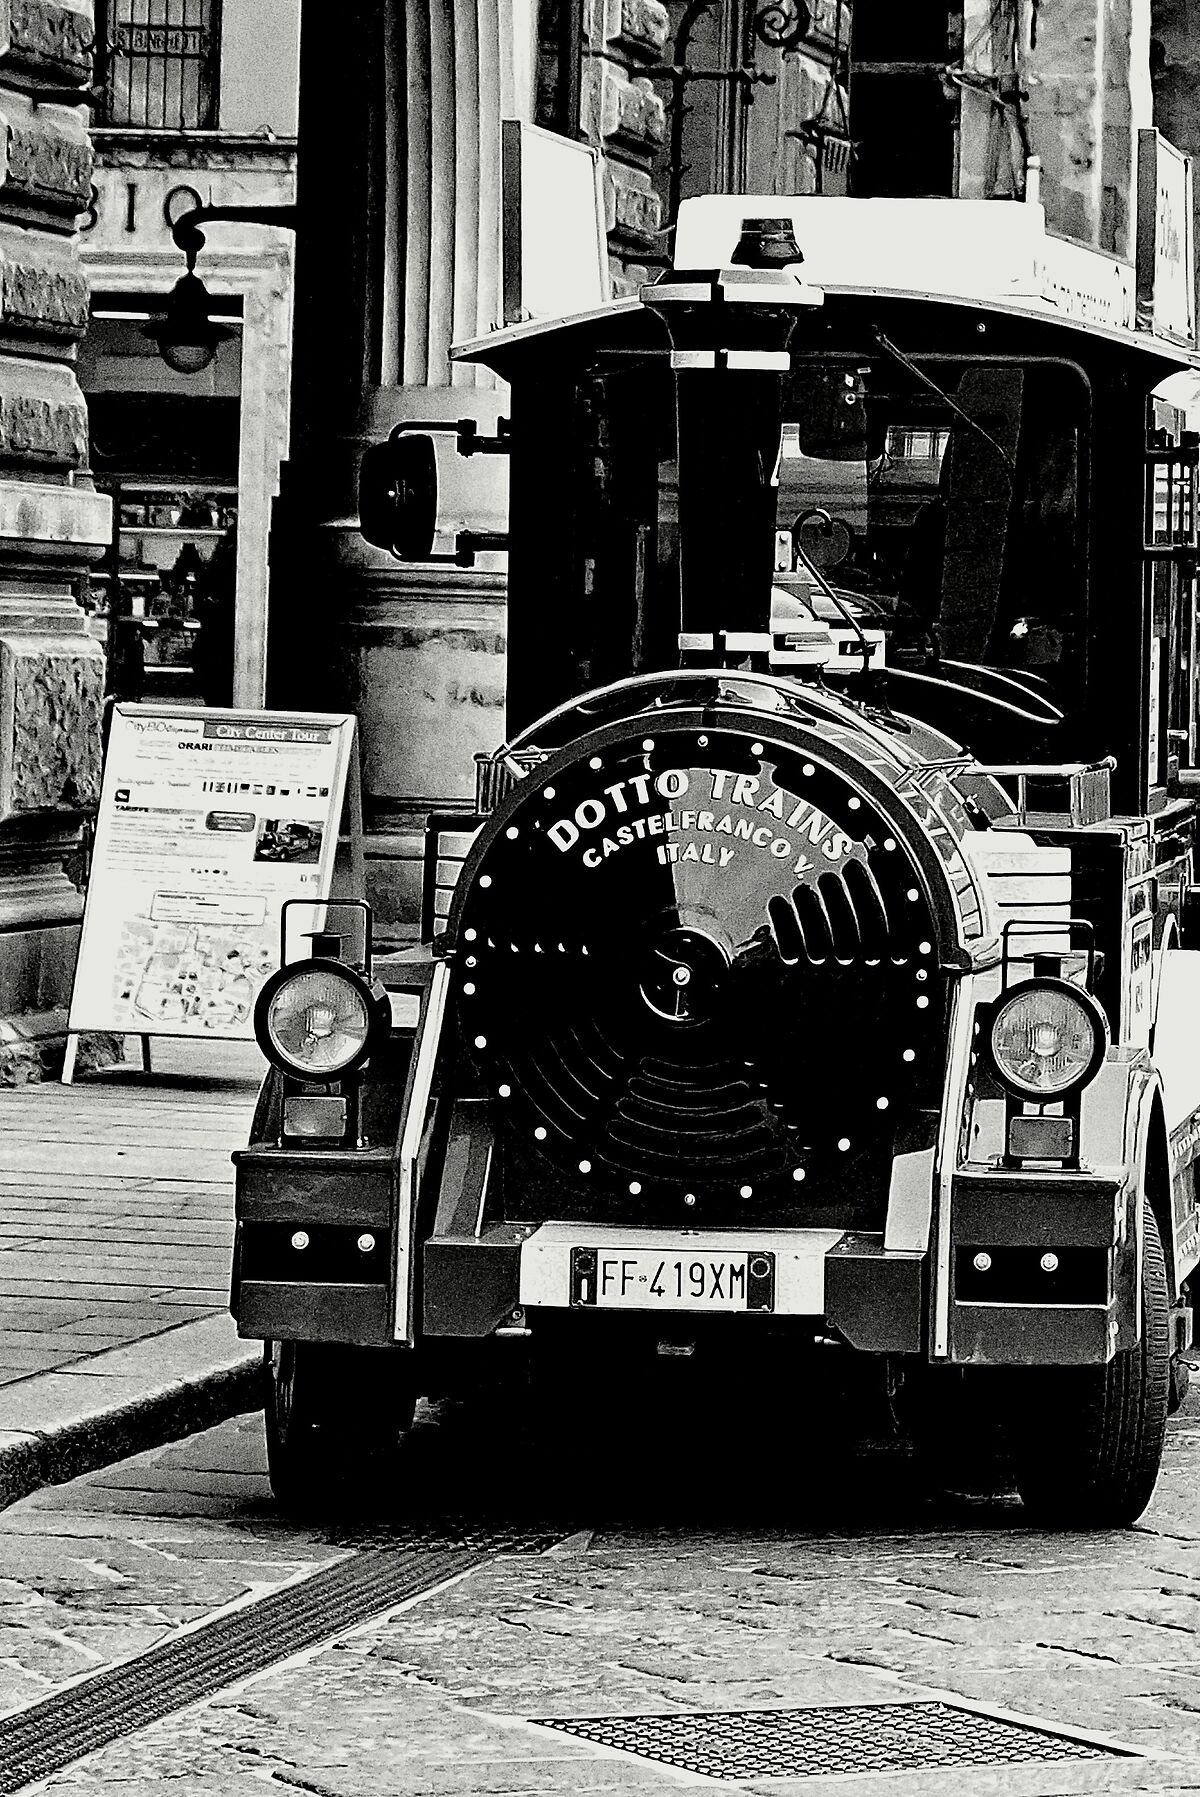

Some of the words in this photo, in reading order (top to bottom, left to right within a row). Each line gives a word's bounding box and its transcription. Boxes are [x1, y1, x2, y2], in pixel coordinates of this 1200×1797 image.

[216, 724, 242, 739] City
[245, 726, 288, 741] Center
[289, 728, 320, 742] Tour
[177, 741, 213, 751] ORARI
[547, 768, 690, 852] DOTTO
[710, 769, 853, 862] TRAINS
[582, 810, 792, 868] CASTELFRANCO
[656, 842, 736, 867] ITALY
